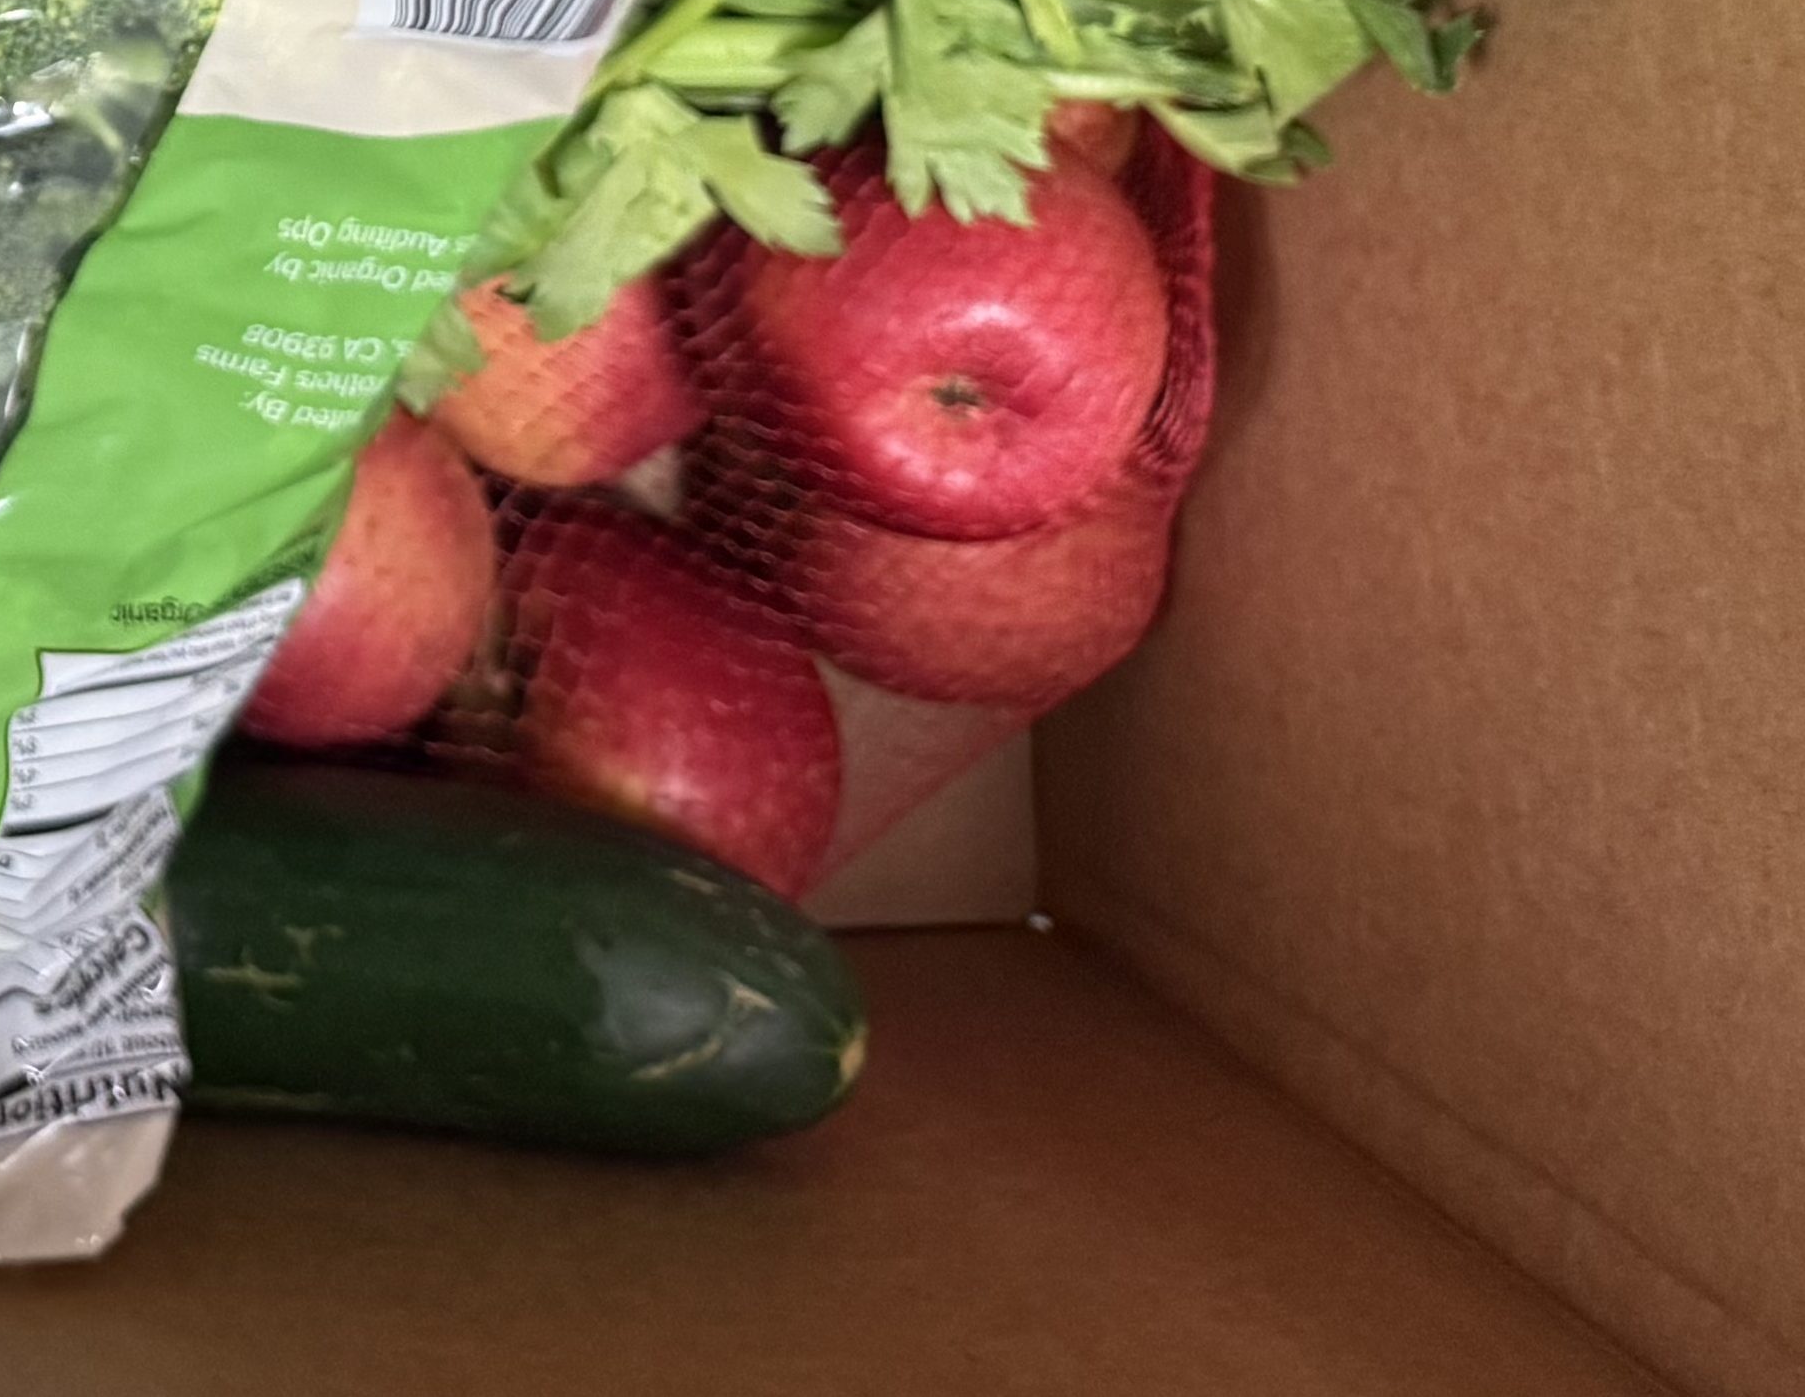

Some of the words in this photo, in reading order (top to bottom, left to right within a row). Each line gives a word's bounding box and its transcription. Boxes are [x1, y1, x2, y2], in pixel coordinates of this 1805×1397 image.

[278, 215, 333, 247] Ops
[337, 217, 449, 258] Auditing
[264, 251, 303, 281] by
[307, 255, 407, 292] Organic
[242, 324, 338, 360] 93908
[344, 337, 386, 362] CA
[196, 345, 287, 387] Farms
[295, 371, 388, 396] others
